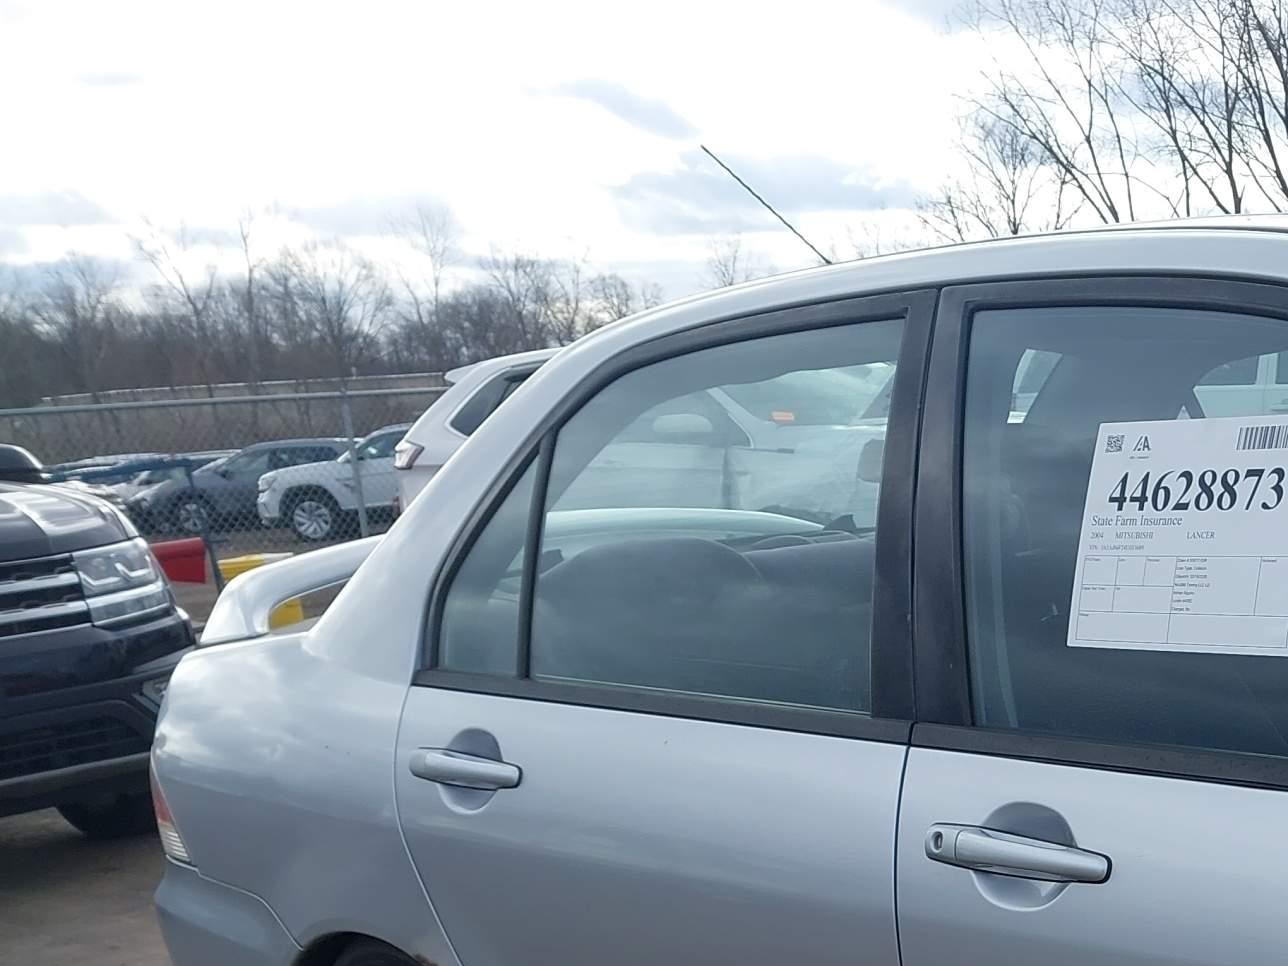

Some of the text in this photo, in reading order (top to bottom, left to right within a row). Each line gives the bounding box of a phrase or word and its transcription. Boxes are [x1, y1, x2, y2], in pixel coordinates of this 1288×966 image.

[1108, 467, 1286, 512] 44628873
[1091, 515, 1183, 526] State Farm Insurance
[1115, 531, 1154, 539] MITSUBISHI
[1186, 530, 1215, 539] LANCER
